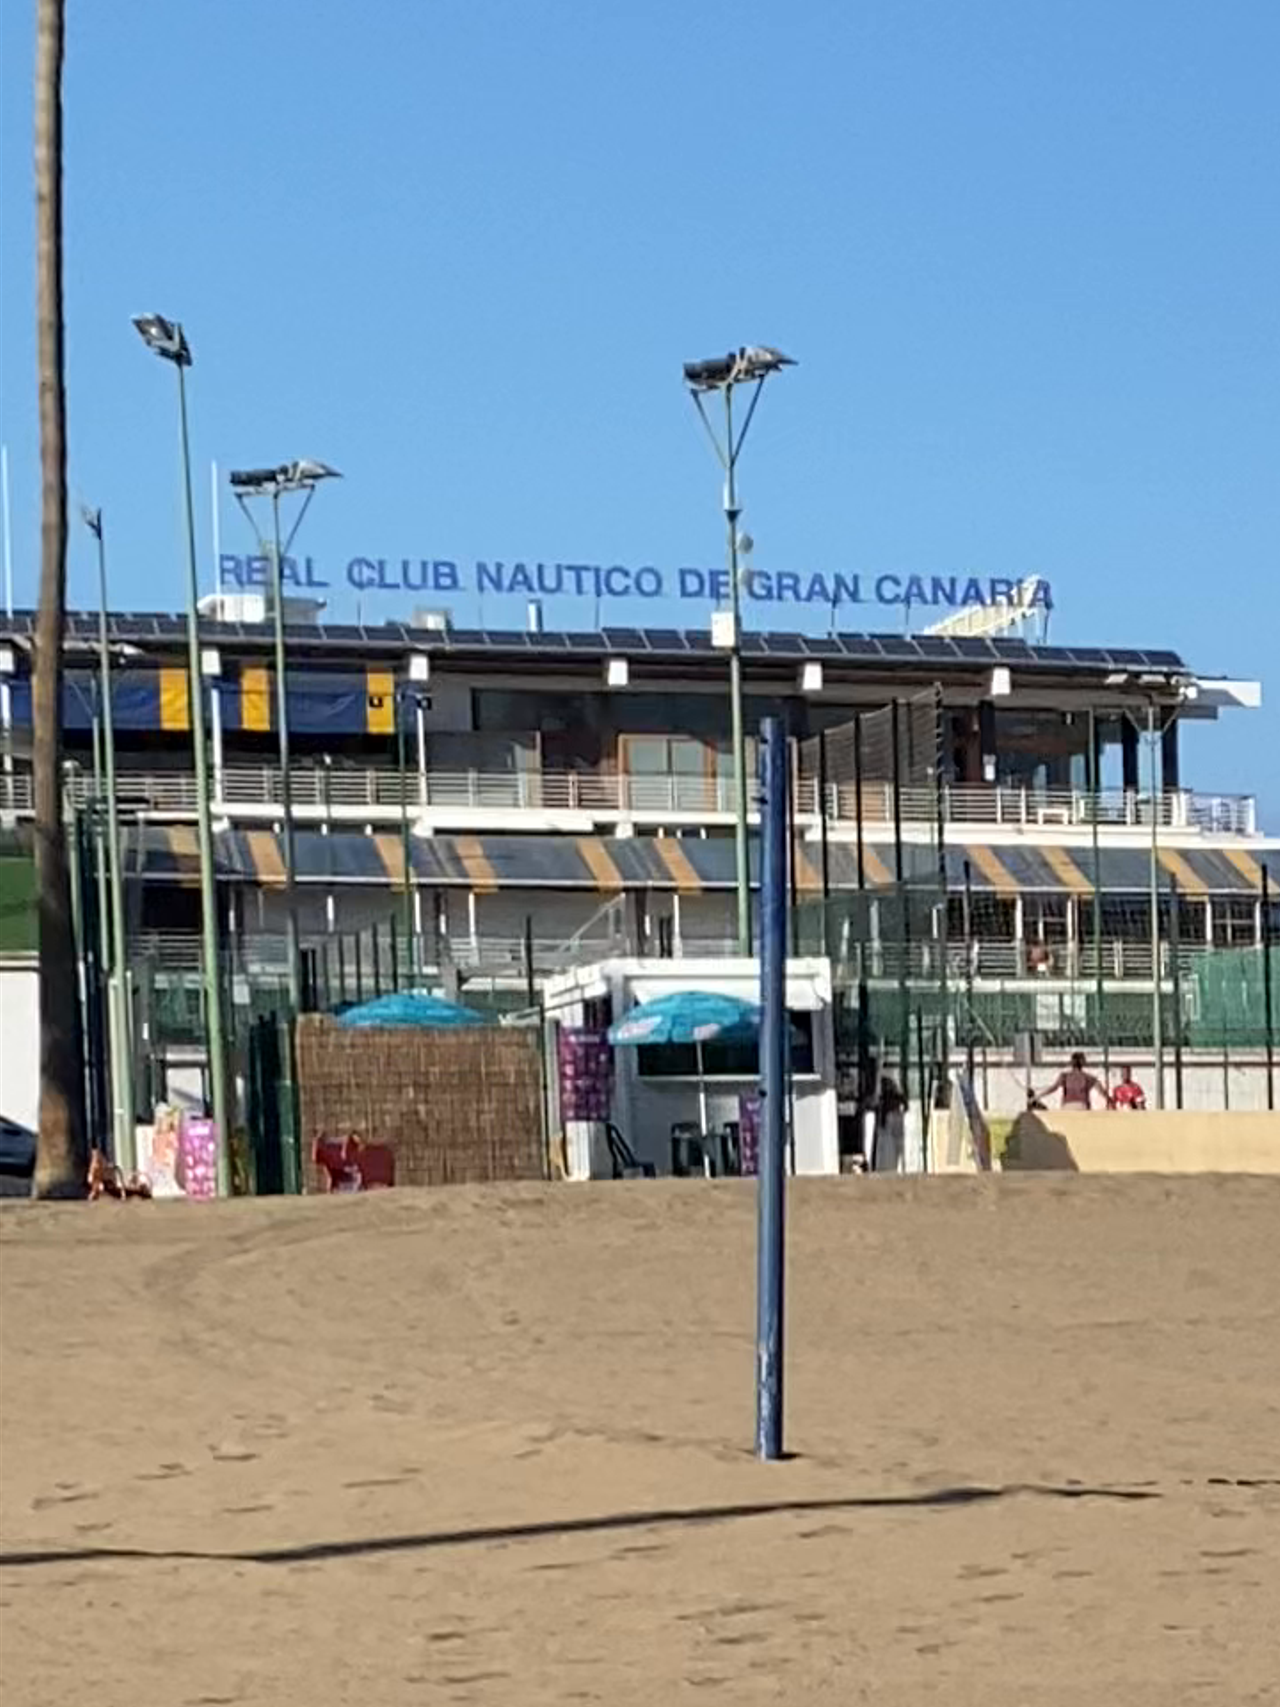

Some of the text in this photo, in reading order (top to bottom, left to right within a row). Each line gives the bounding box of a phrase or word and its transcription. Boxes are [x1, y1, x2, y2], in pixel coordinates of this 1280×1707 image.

[219, 553, 1053, 609] REAL CLUB NAUTICO DE GRAN CANARIA
